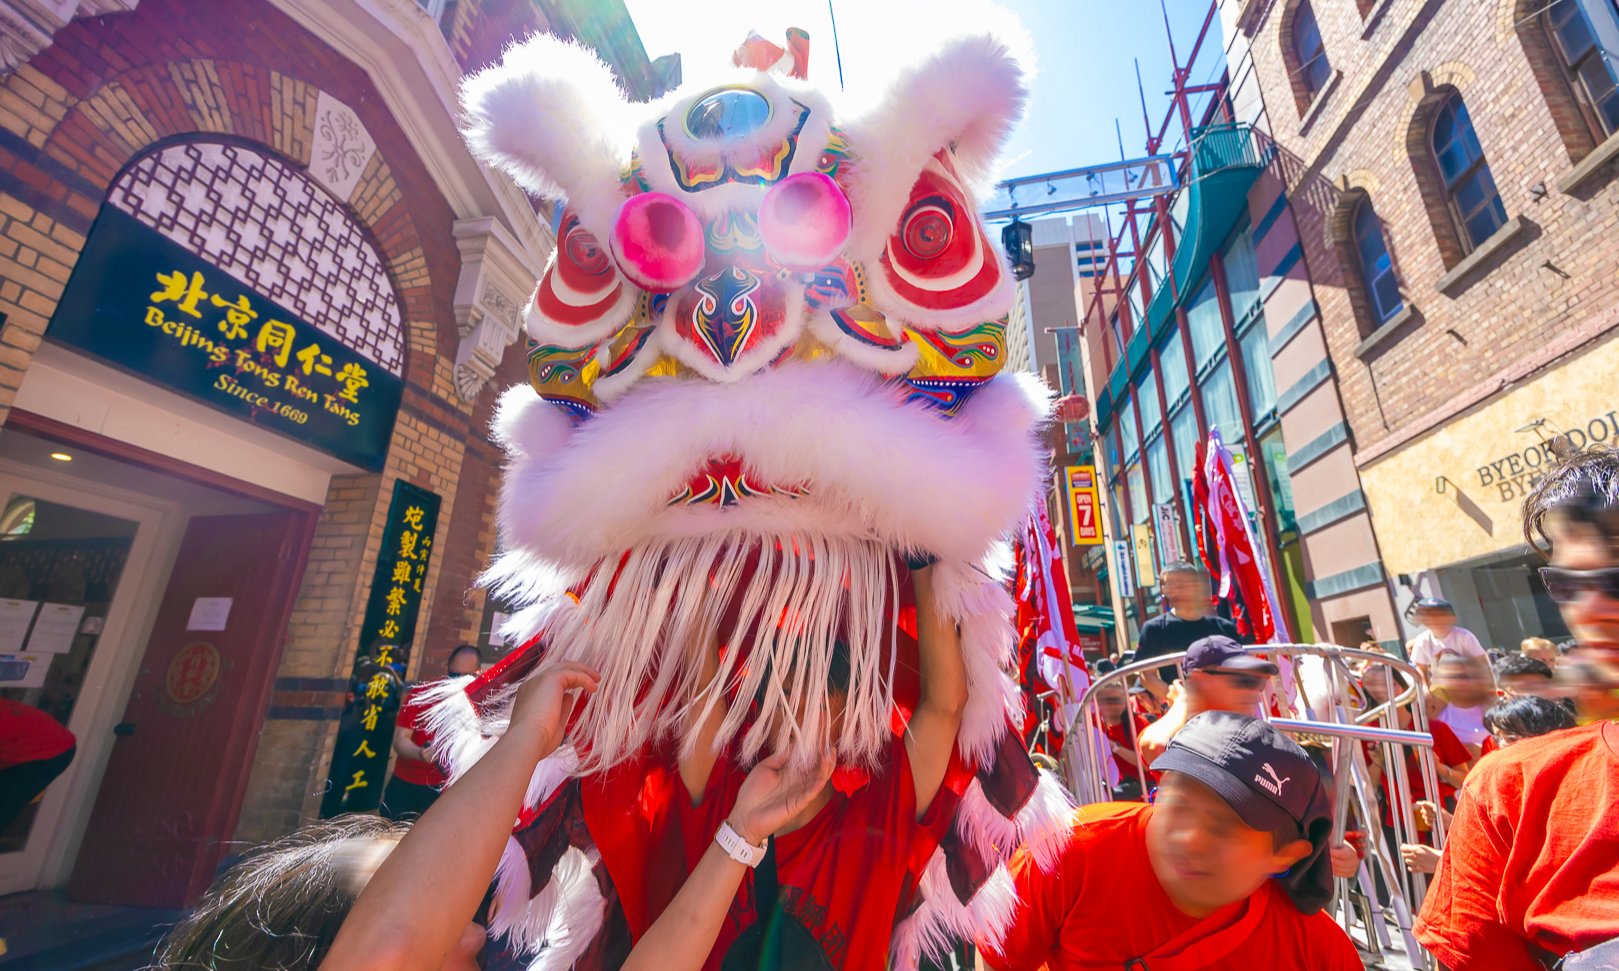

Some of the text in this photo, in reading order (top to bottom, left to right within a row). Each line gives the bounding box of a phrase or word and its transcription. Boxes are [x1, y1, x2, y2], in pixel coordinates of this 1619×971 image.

[150, 270, 369, 403] 北京同仁堂
[144, 306, 360, 425] Beijing Tong Ren Tang
[214, 374, 308, 424] Since 1669
[1078, 505, 1092, 526] 7
[1080, 526, 1096, 537] DAYS
[1254, 774, 1278, 795] PUMA
